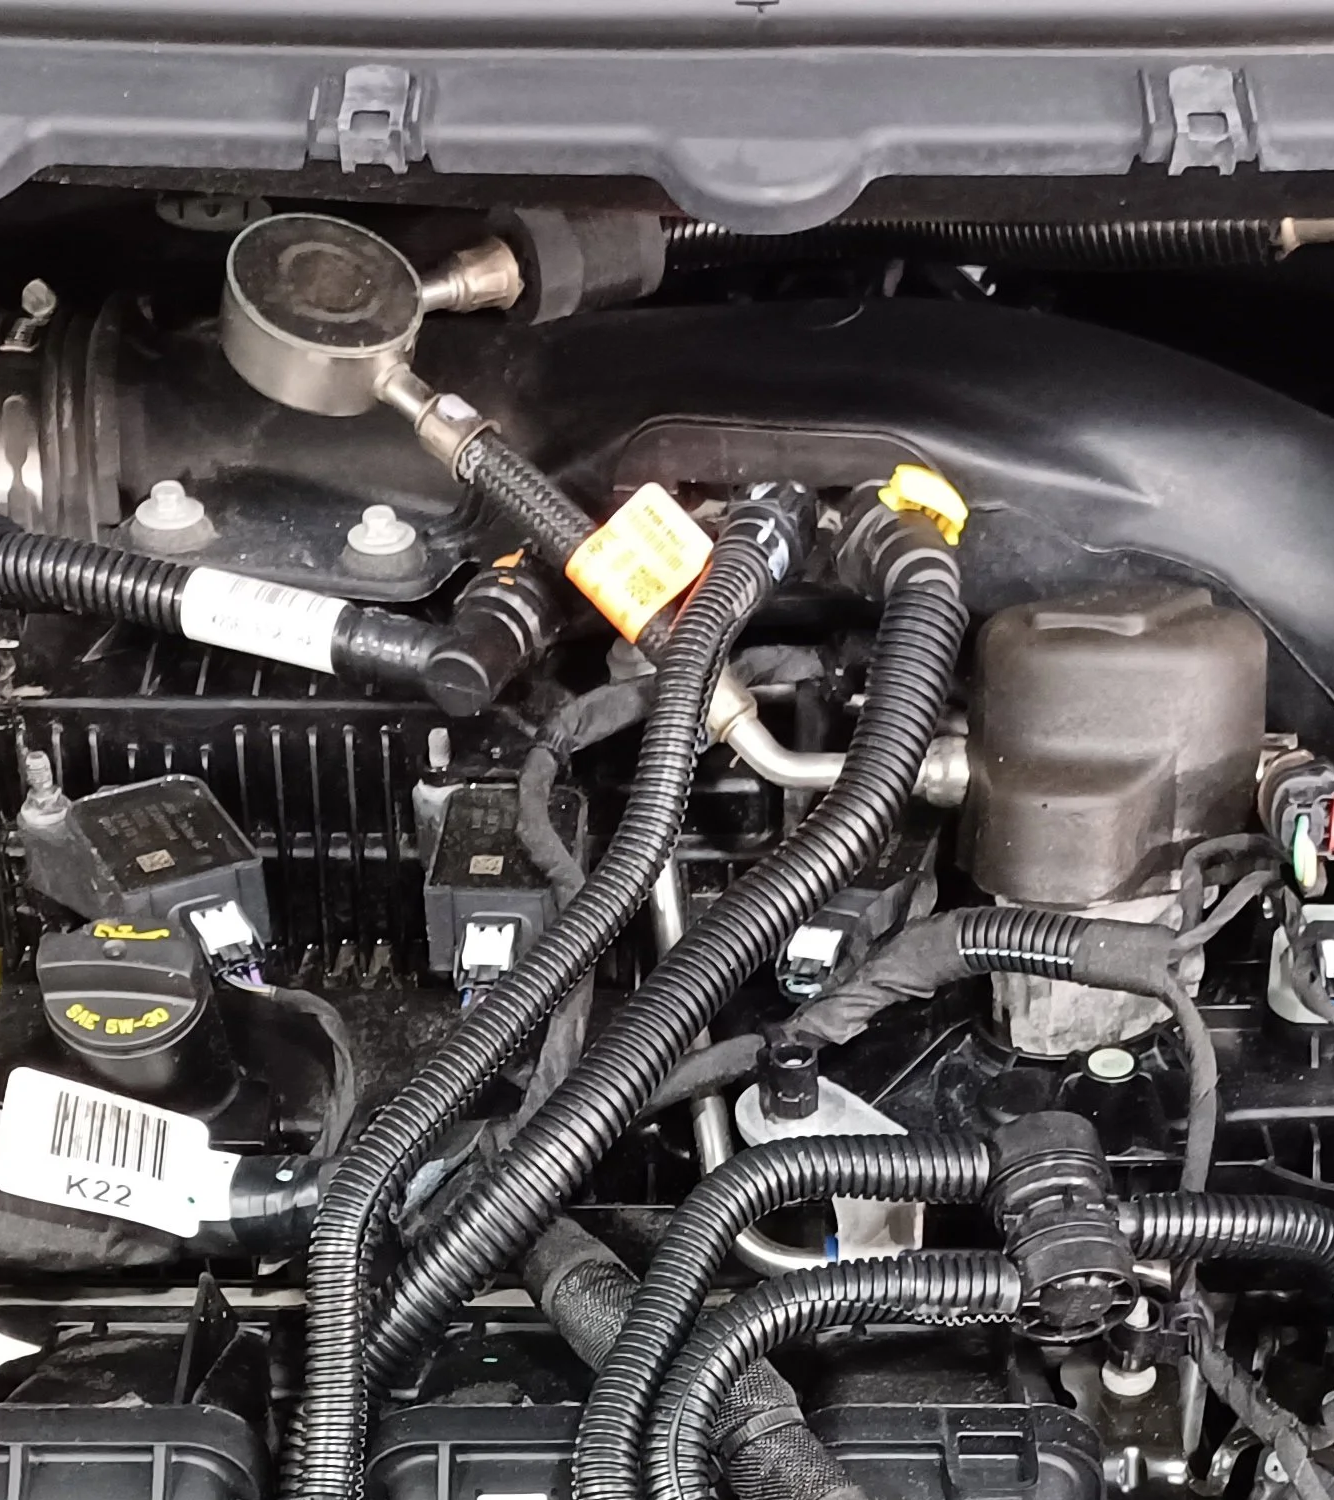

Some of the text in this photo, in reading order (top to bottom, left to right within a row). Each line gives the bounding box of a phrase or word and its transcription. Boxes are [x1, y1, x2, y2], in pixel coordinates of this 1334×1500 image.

[65, 1003, 170, 1035] SAE 5W-30
[65, 1174, 132, 1208] K22
